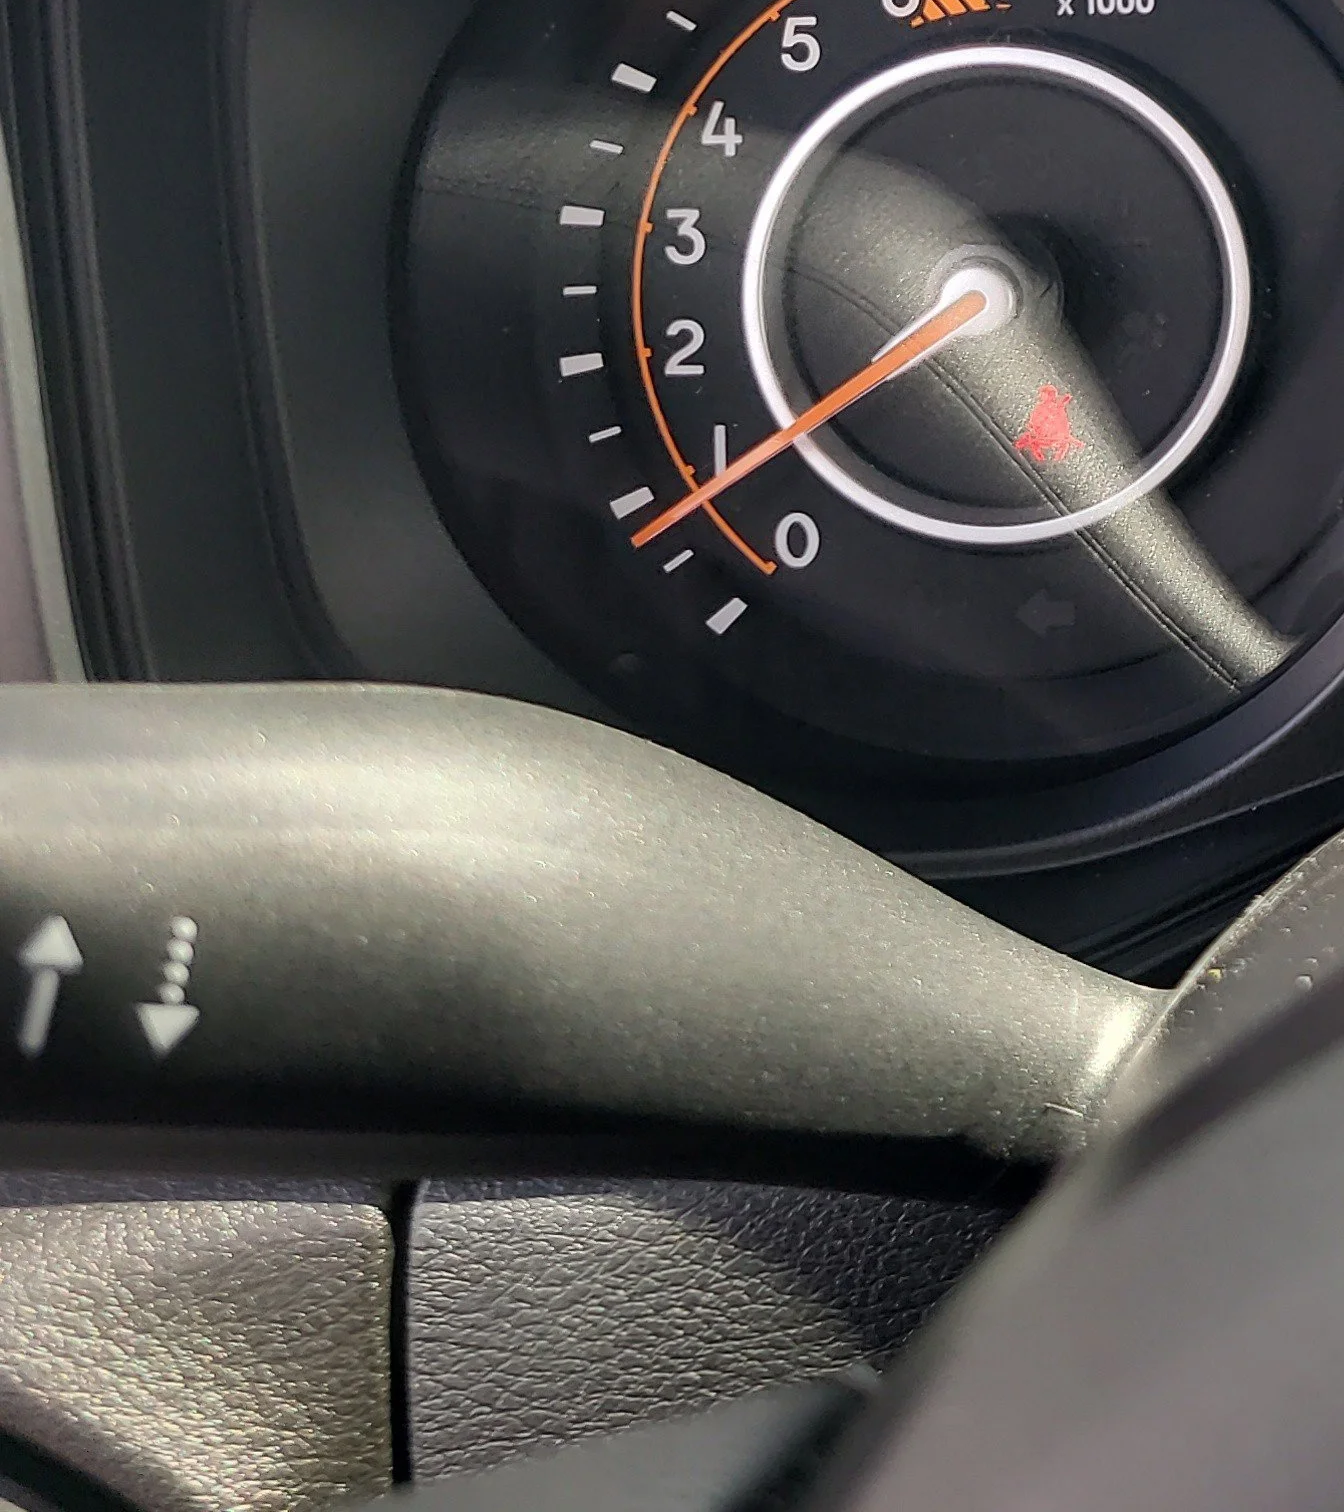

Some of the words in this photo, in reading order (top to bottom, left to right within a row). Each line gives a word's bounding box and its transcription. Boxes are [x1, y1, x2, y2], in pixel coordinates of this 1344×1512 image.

[780, 16, 821, 72] 5
[701, 101, 743, 156] 4
[664, 209, 706, 265] 3
[664, 320, 704, 375] 2
[774, 512, 820, 568] 0
